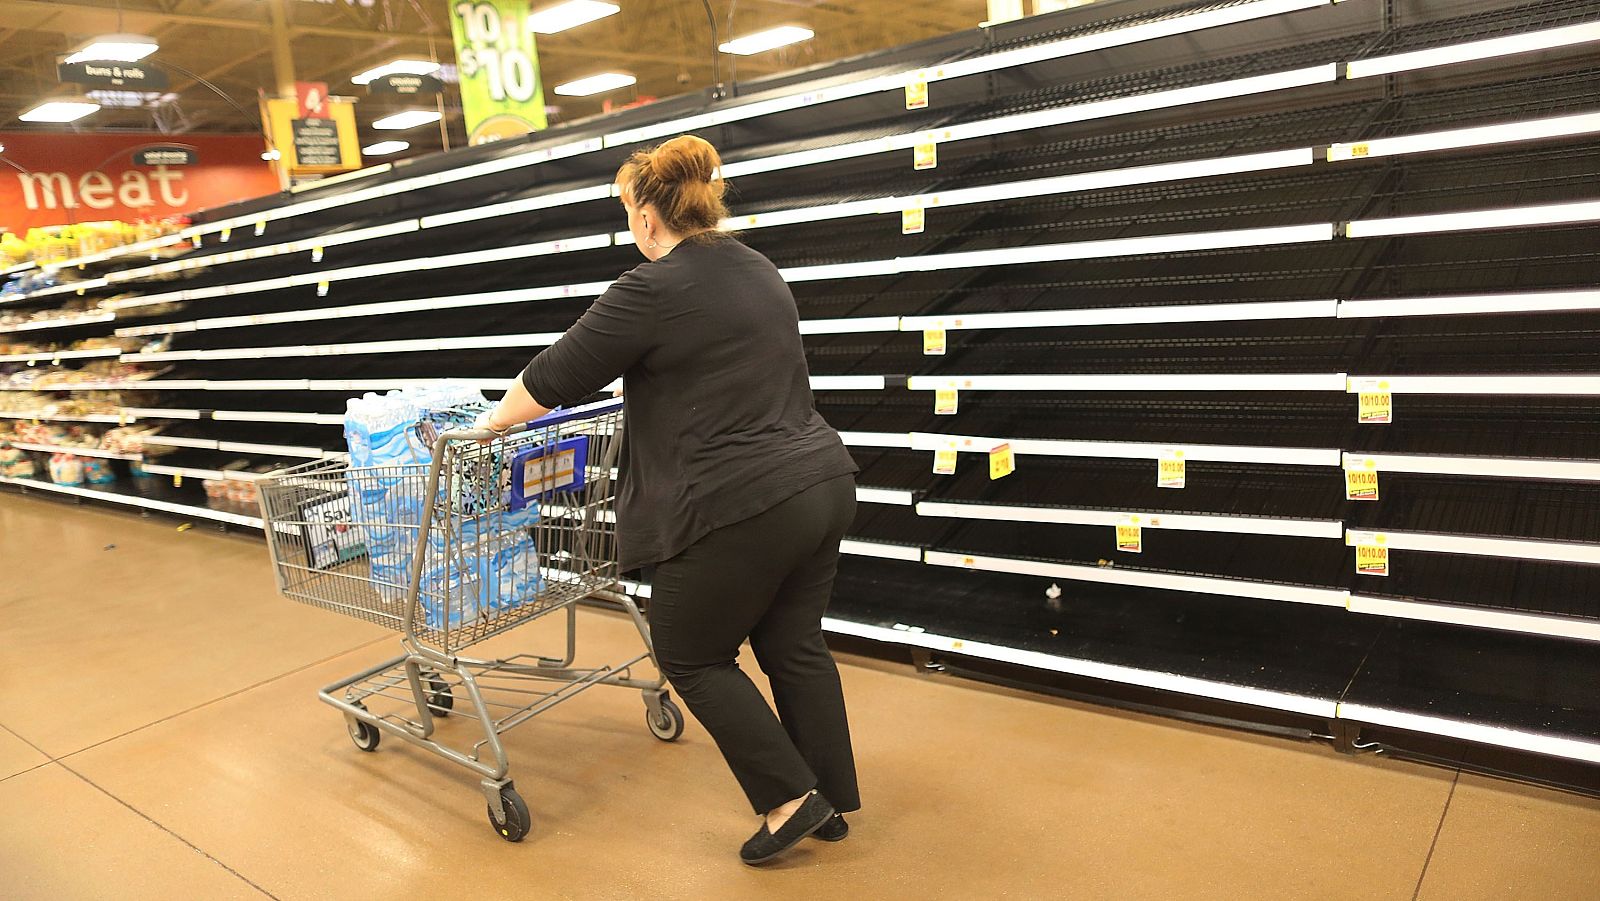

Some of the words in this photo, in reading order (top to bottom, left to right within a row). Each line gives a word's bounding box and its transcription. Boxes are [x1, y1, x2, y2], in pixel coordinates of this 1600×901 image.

[457, 2, 500, 43] 10
[85, 64, 112, 77] buns
[113, 66, 122, 78] &
[123, 68, 145, 79] rolls
[461, 46, 537, 102] $10
[305, 88, 322, 113] 4
[17, 167, 189, 210] meat
[1358, 547, 1386, 559] 10/10.00
